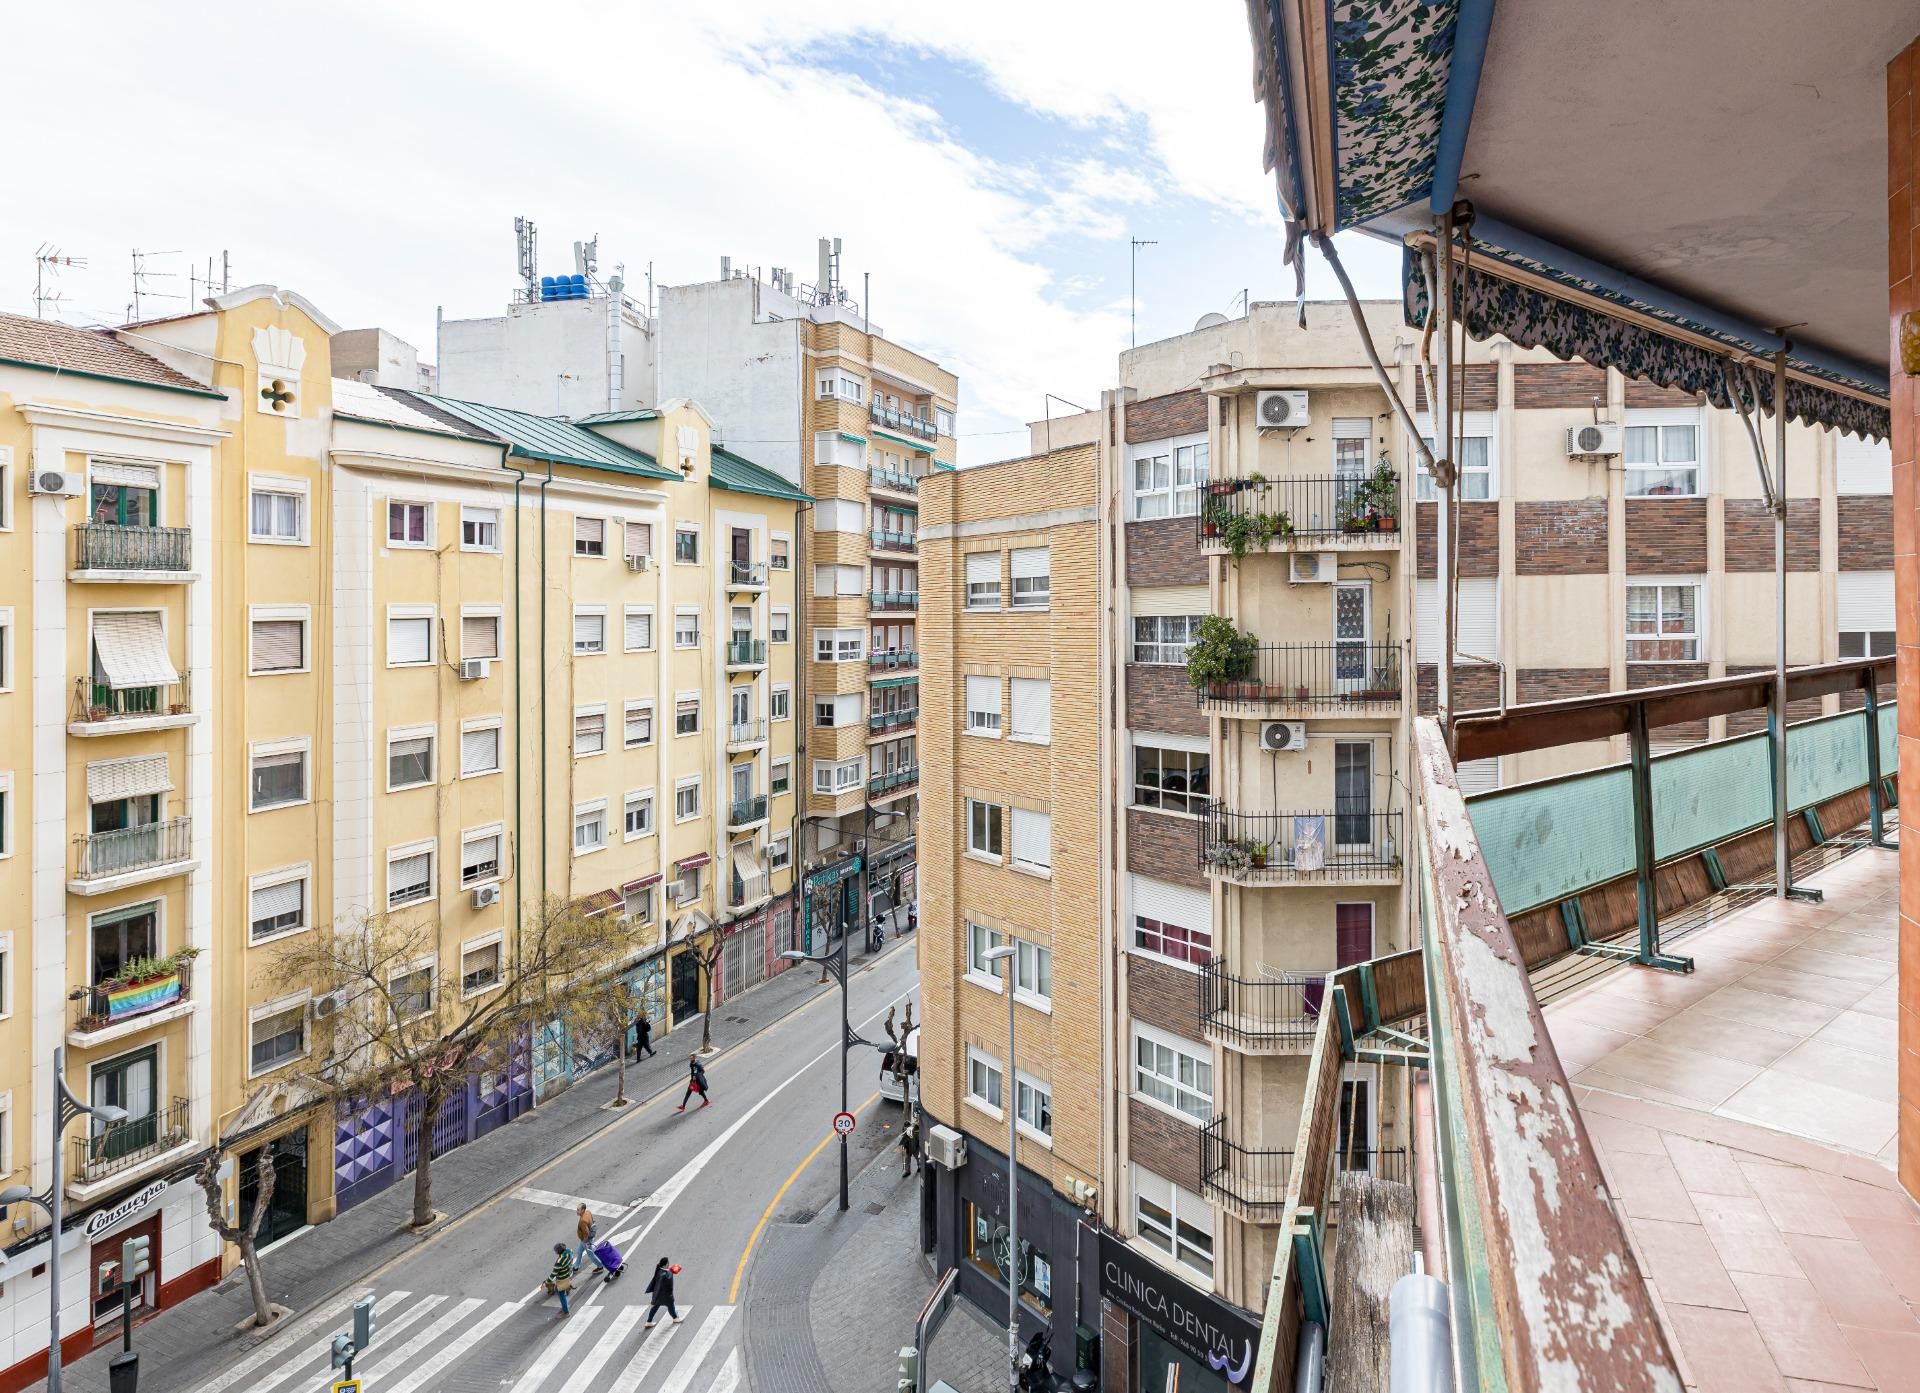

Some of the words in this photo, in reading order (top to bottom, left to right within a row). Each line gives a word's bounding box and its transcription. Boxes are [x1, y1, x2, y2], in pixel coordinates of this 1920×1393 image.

[838, 1119, 850, 1128] 30
[86, 1181, 167, 1236] Consuegra
[1105, 1261, 1169, 1319] CLINICA
[1173, 1302, 1239, 1364] DENTAL
